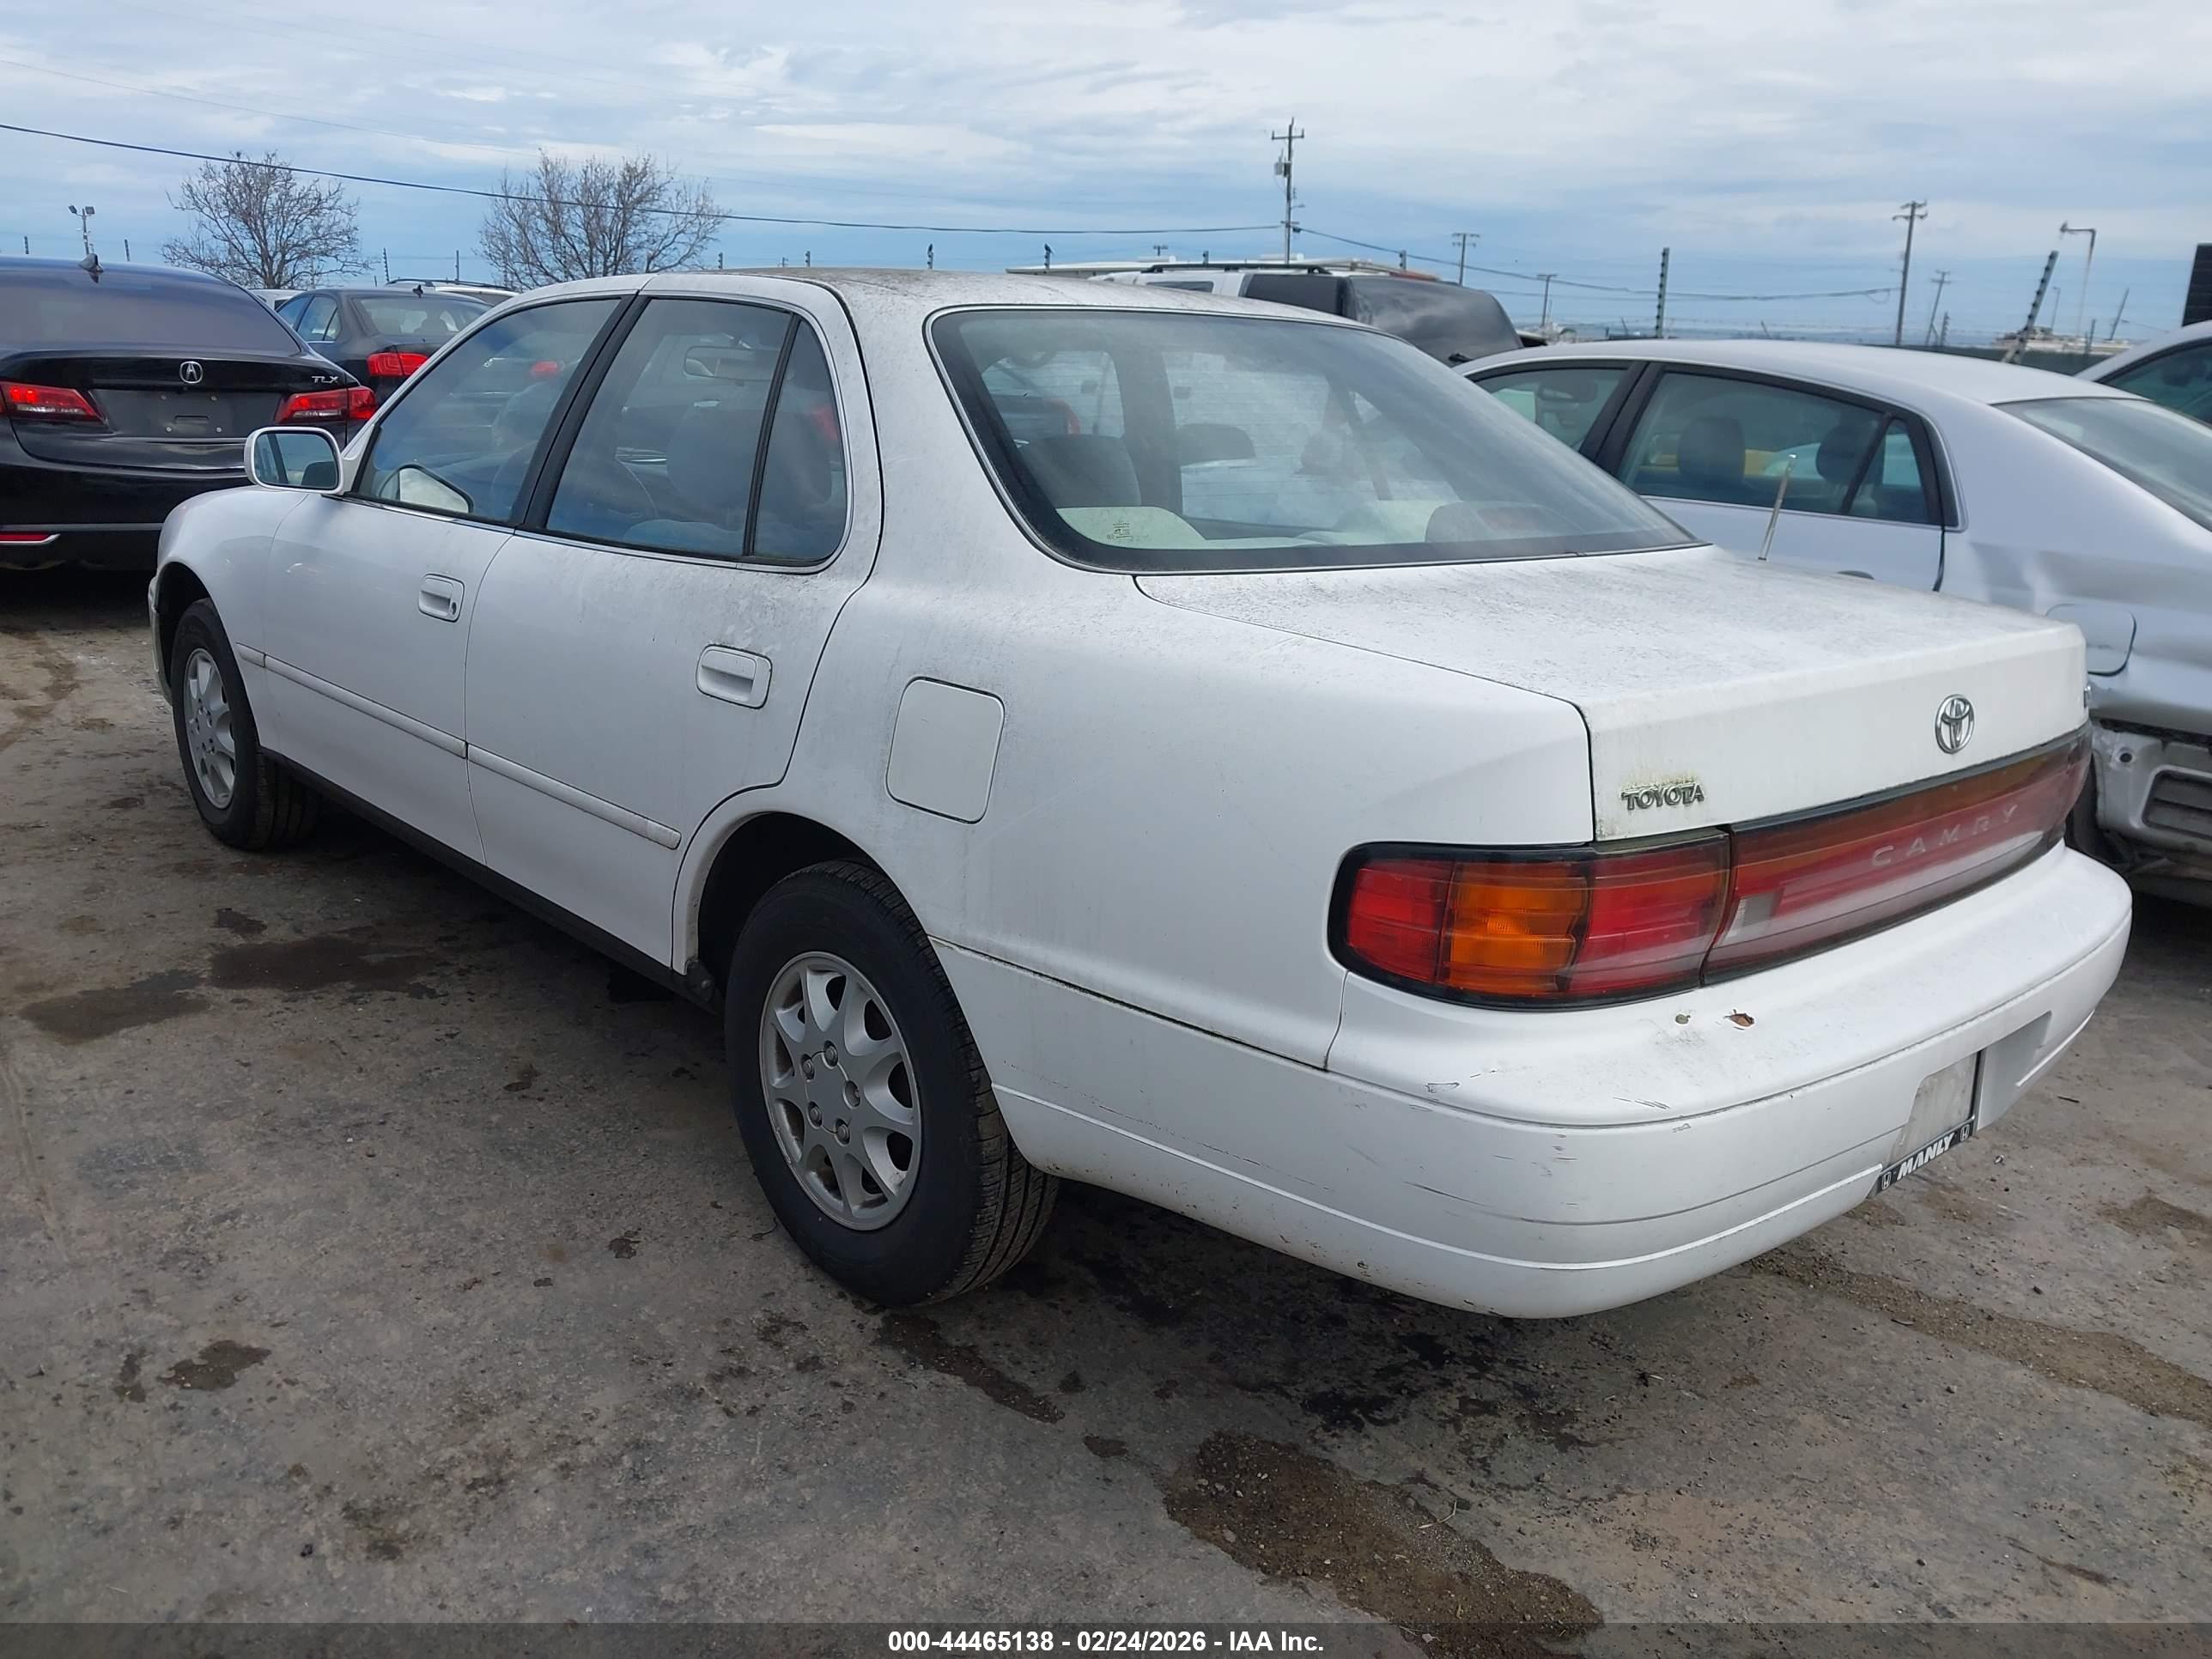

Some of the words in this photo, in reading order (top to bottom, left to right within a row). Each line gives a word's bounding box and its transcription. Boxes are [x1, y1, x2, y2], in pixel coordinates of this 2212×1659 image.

[311, 375, 338, 384] TLX
[1620, 782, 1705, 811] TOYOTA
[1871, 804, 2018, 867] CAMRY
[1896, 1132, 1955, 1182] MANLY
